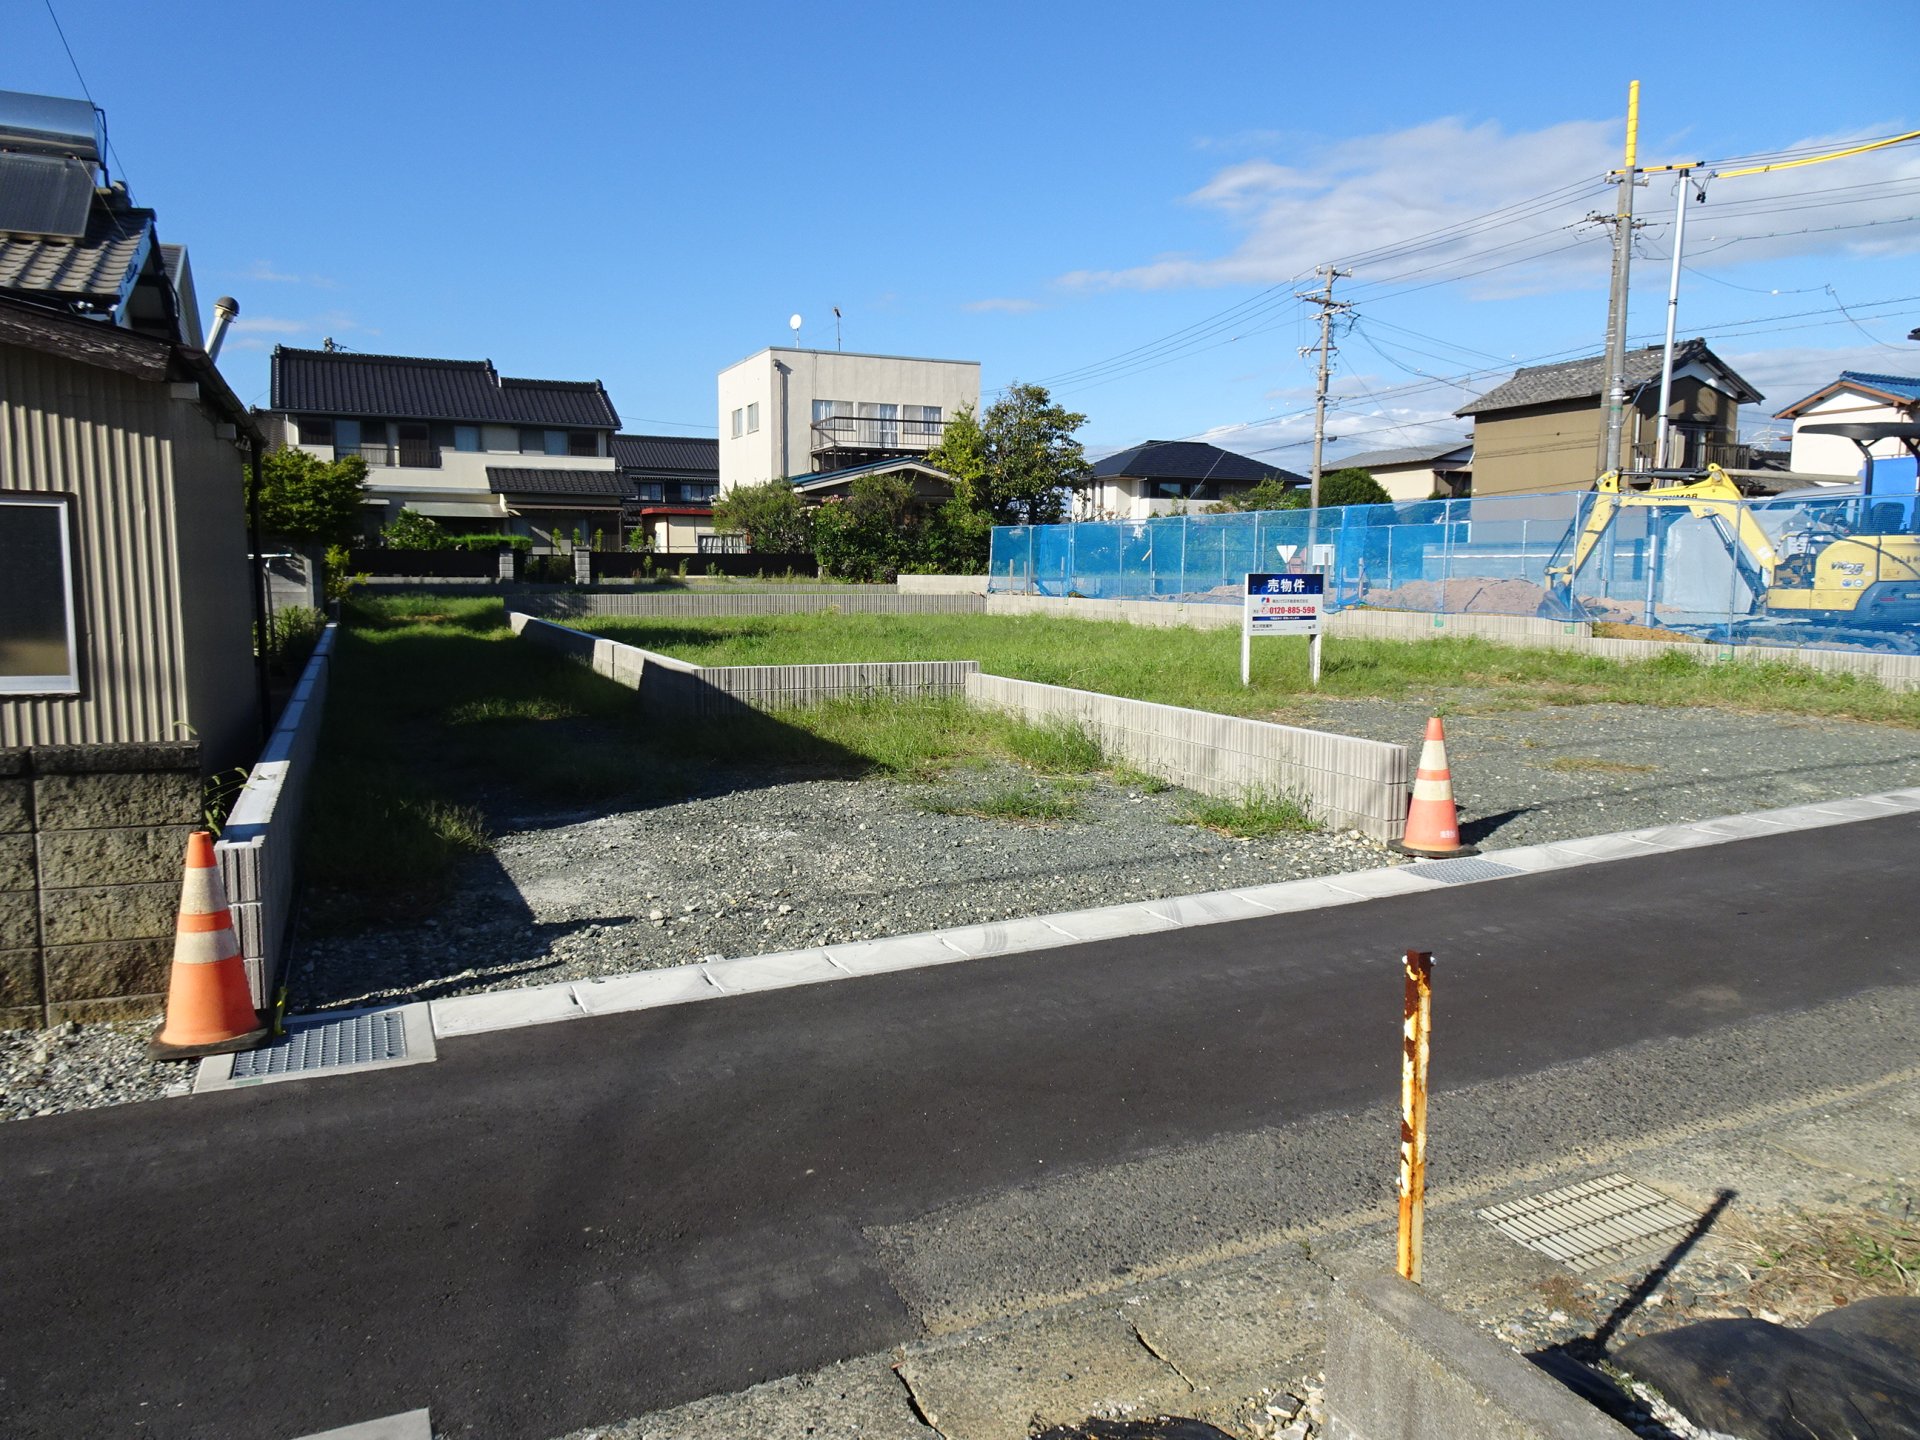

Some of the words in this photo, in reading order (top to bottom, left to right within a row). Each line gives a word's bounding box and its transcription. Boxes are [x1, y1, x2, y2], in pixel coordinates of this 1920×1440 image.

[1267, 578, 1305, 592] 売物件
[1270, 606, 1316, 614] 0120-885-598
